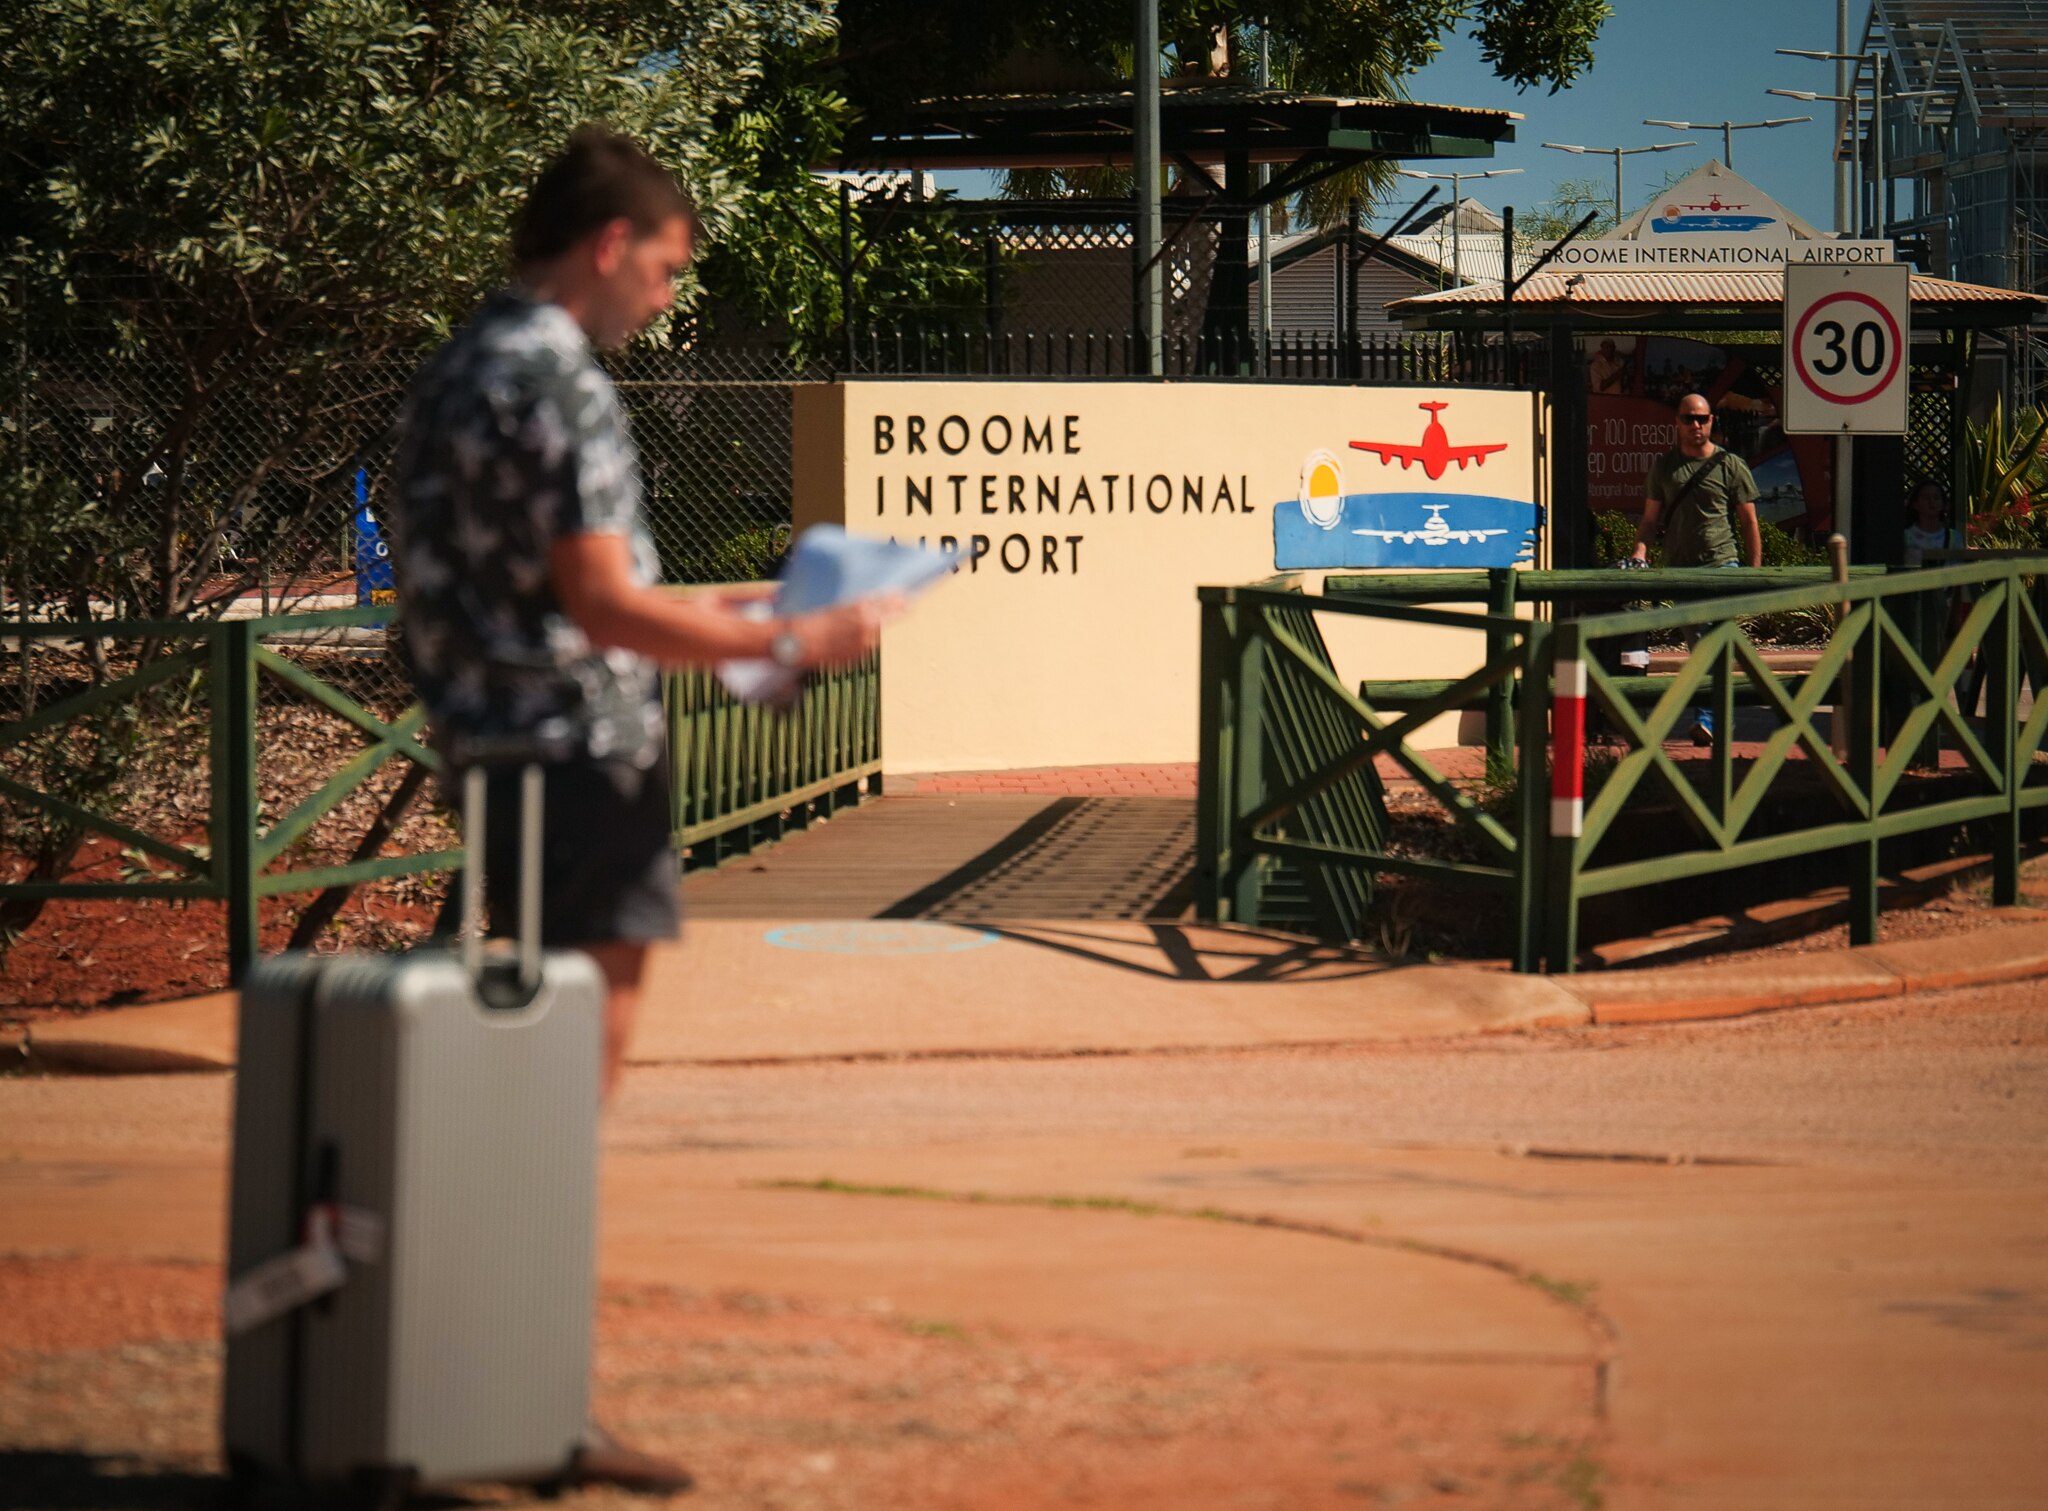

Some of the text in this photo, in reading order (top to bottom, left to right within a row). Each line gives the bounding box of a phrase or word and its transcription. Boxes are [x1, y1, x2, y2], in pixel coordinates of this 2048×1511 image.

[1635, 247, 1794, 263] INTERNATIONAL
[1803, 247, 1885, 263] AIRPORT
[1812, 320, 1885, 377] 30
[874, 414, 1081, 455] BROOME
[1603, 418, 1626, 445] 100
[877, 474, 1256, 516] INTERNATIONAL
[884, 533, 1084, 575] RPORT
